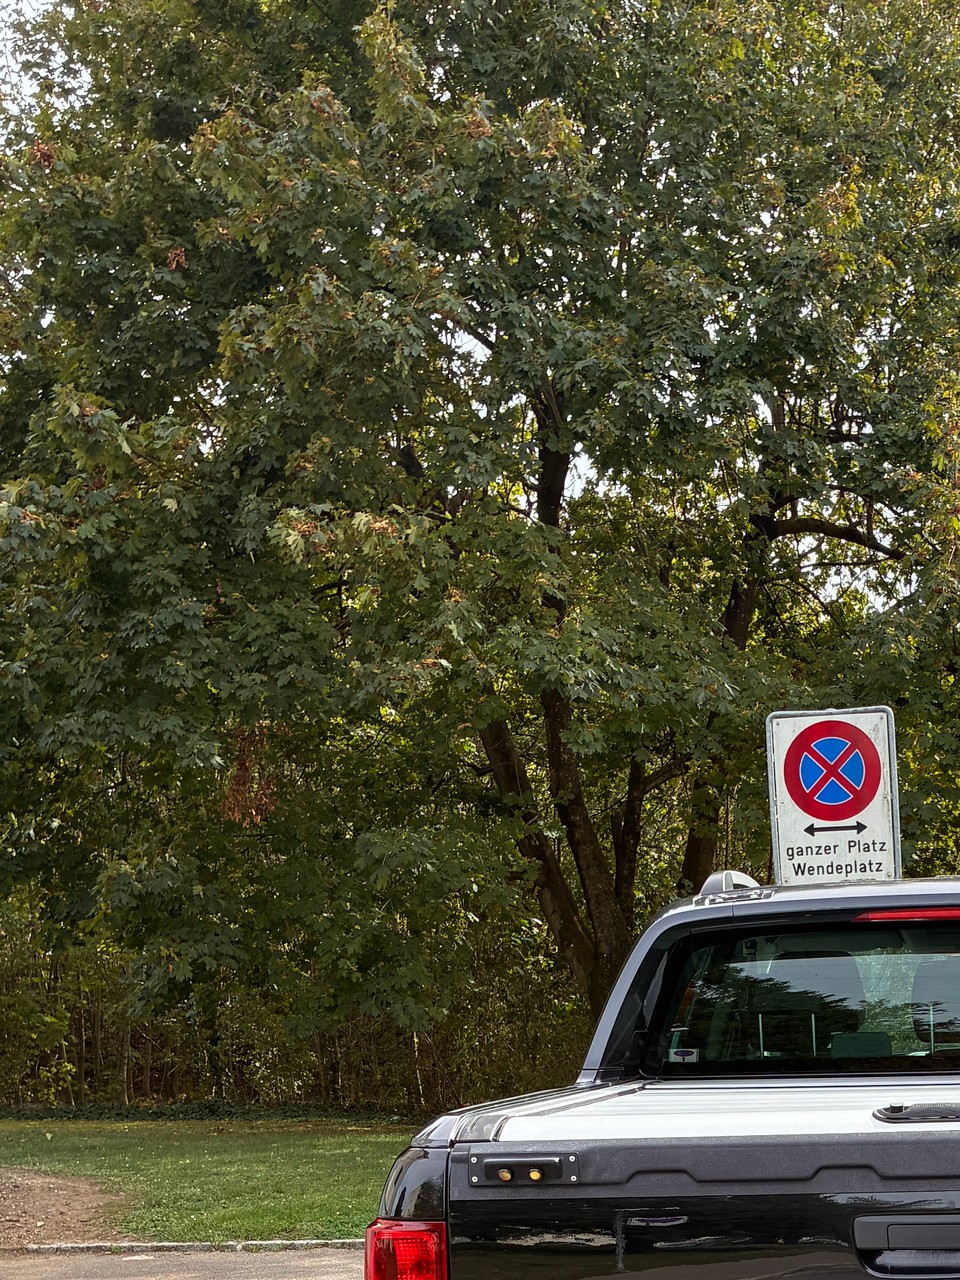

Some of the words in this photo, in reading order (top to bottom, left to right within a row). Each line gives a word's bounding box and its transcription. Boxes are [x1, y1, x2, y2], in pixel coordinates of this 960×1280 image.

[786, 844, 839, 861] ganzer
[847, 839, 887, 854] Platz
[792, 860, 884, 877] Wendeplatz
